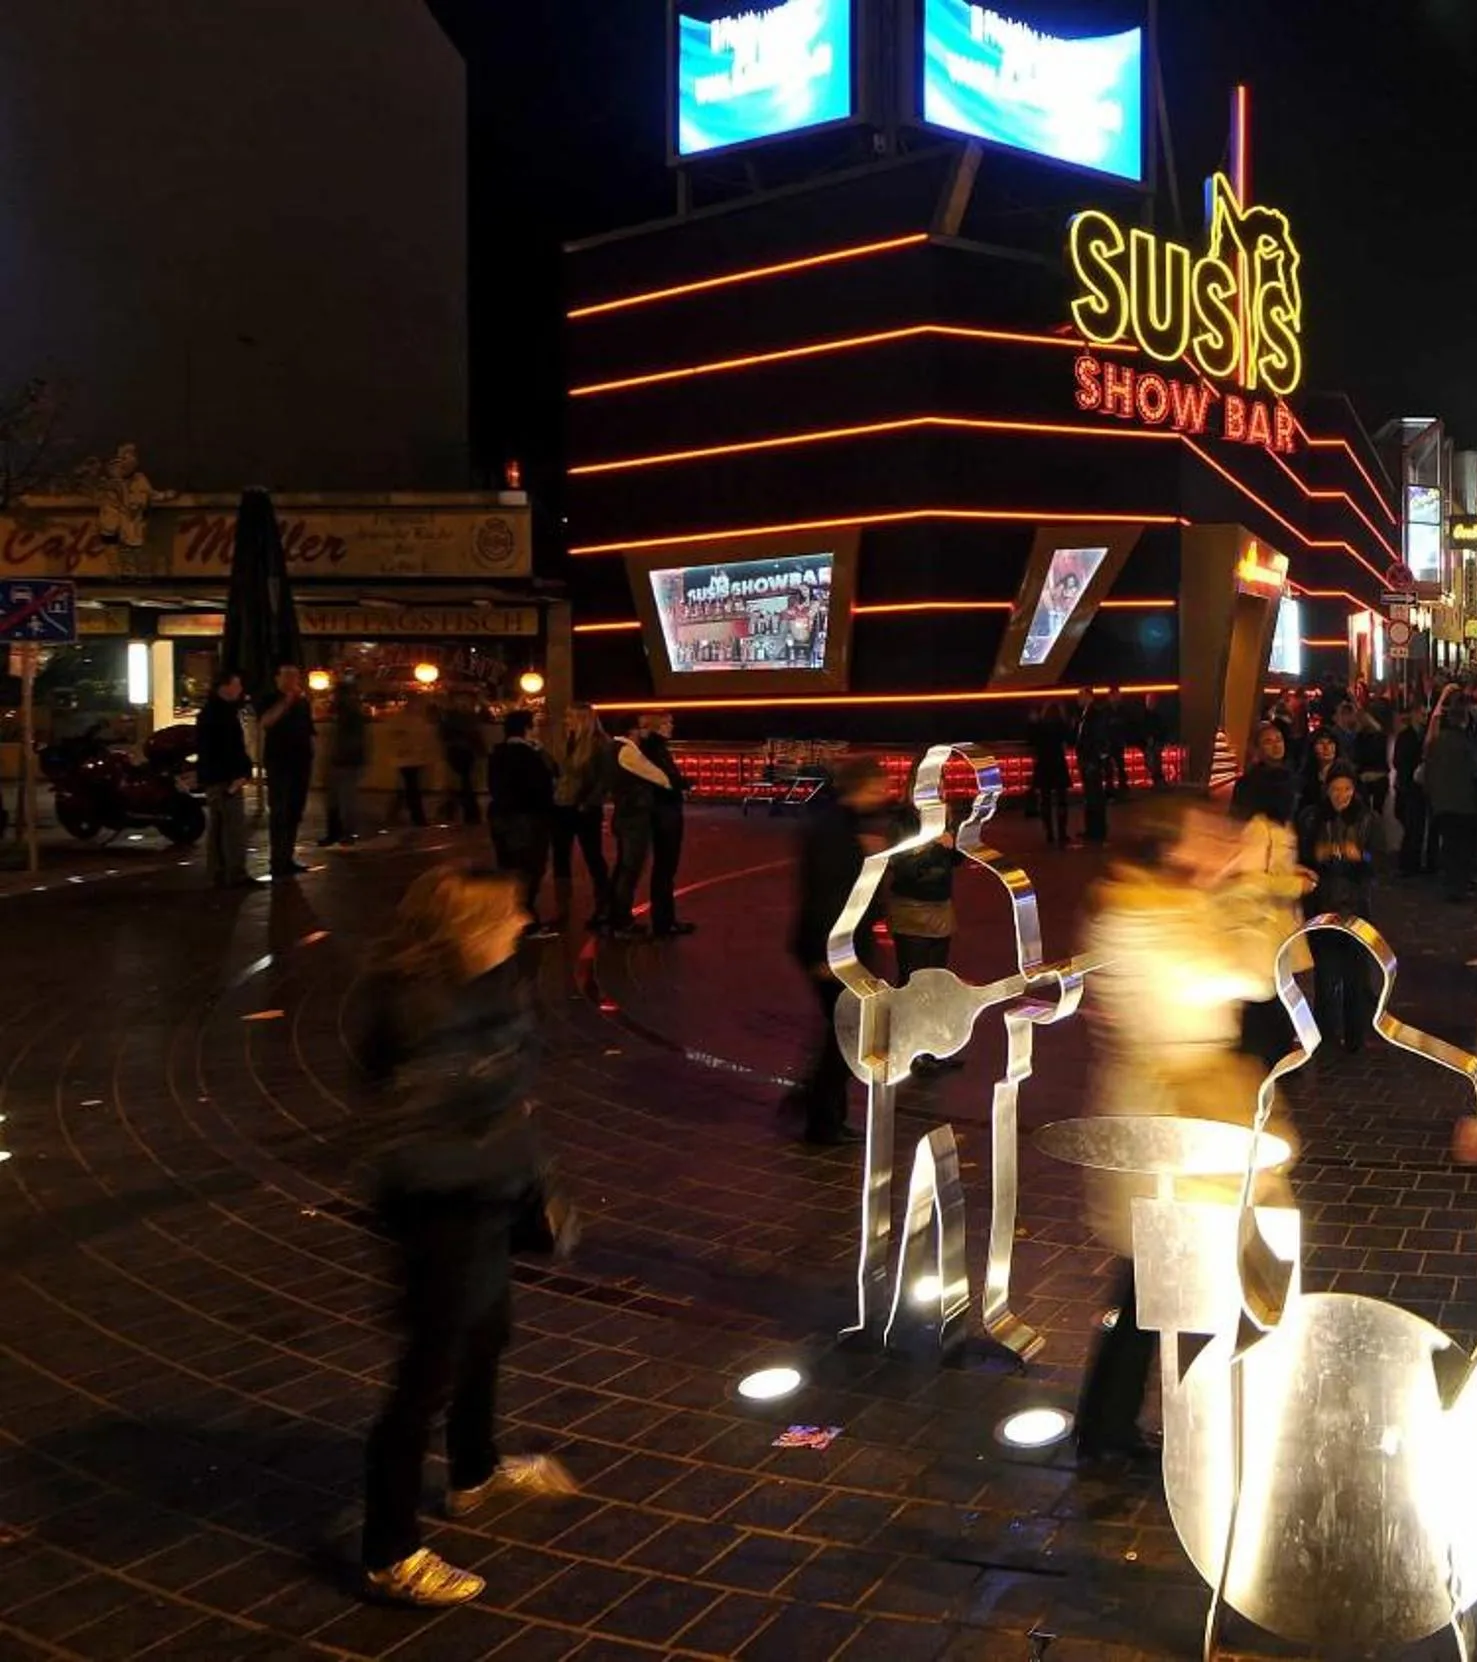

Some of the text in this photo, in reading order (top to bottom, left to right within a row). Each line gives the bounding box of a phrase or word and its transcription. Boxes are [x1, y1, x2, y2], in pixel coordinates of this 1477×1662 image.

[1074, 356, 1297, 454] SHOW BAR
[179, 516, 348, 565] Mler
[303, 611, 523, 632] MITTAGSTISCH
